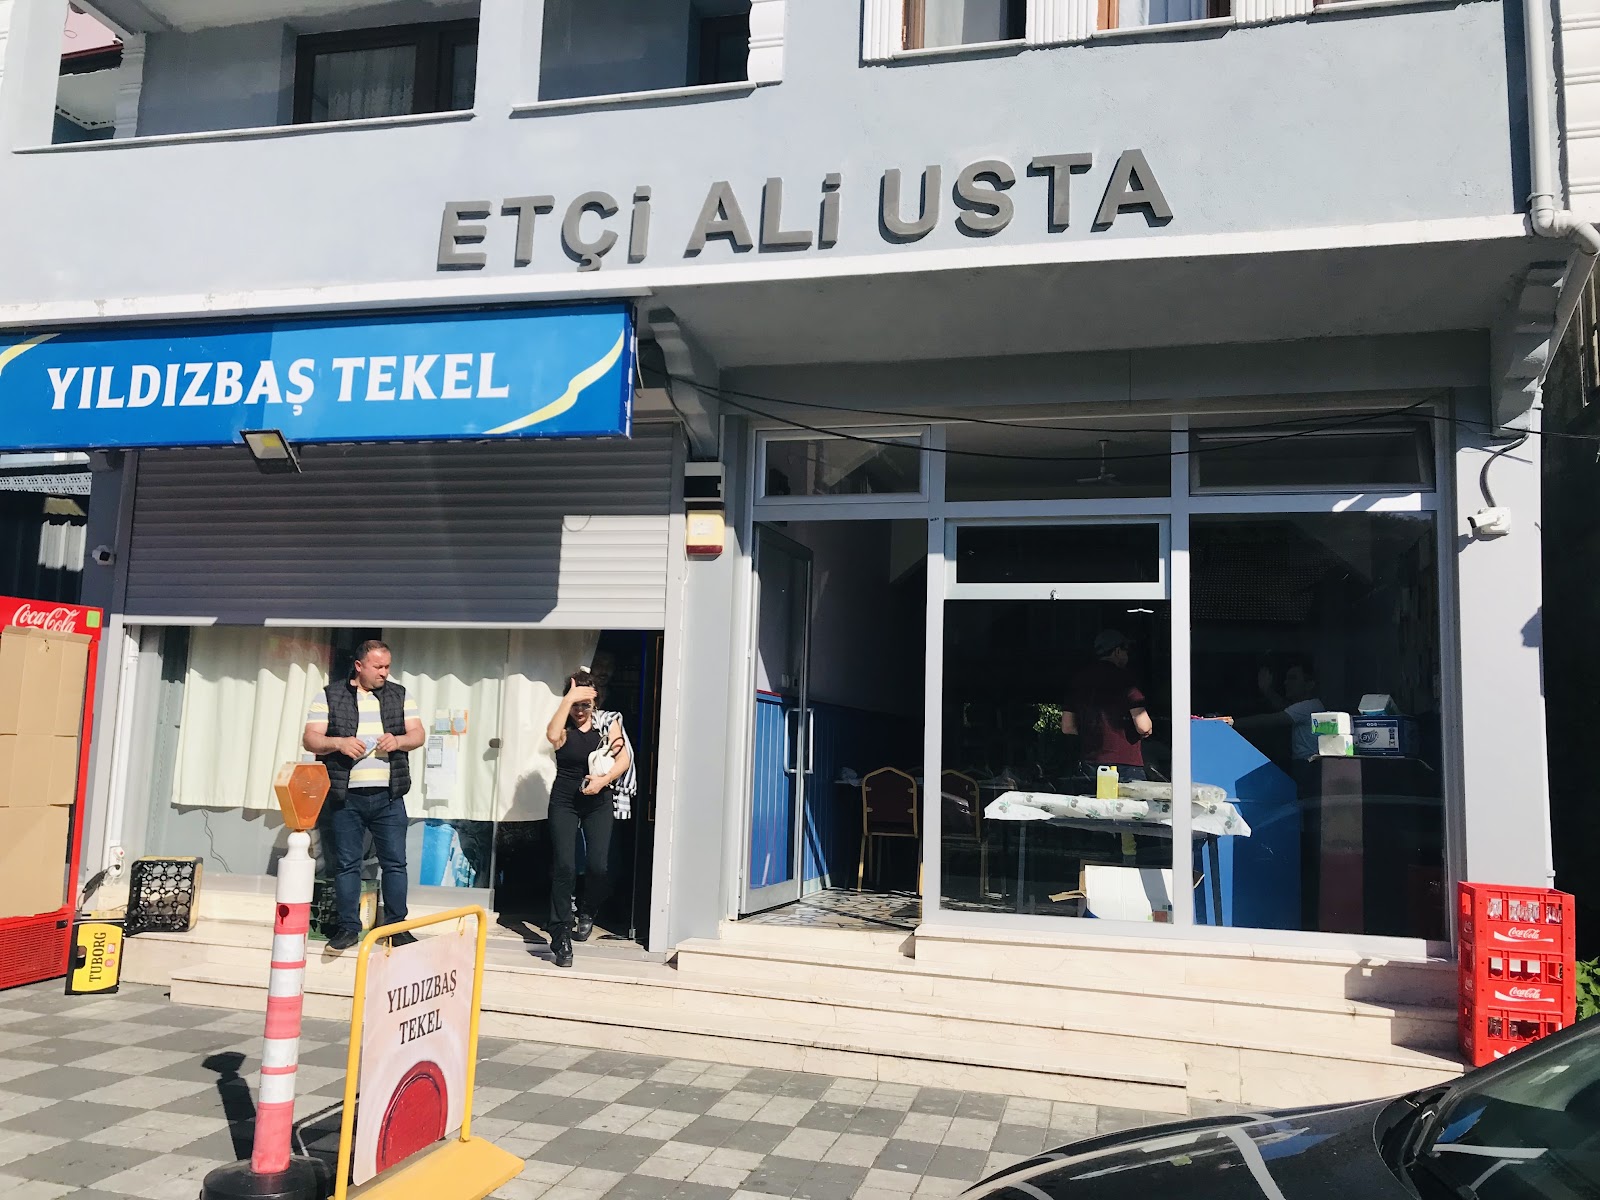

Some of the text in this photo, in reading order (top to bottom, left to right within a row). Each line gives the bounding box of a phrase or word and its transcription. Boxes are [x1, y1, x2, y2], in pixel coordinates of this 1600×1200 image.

[877, 148, 1174, 245] USTA
[47, 352, 510, 416] YILDIZBAŞ TEKEL
[89, 932, 107, 983] TUBORG
[387, 969, 457, 1014] YILDIZBAŞ
[399, 1008, 443, 1045] TEKEL
